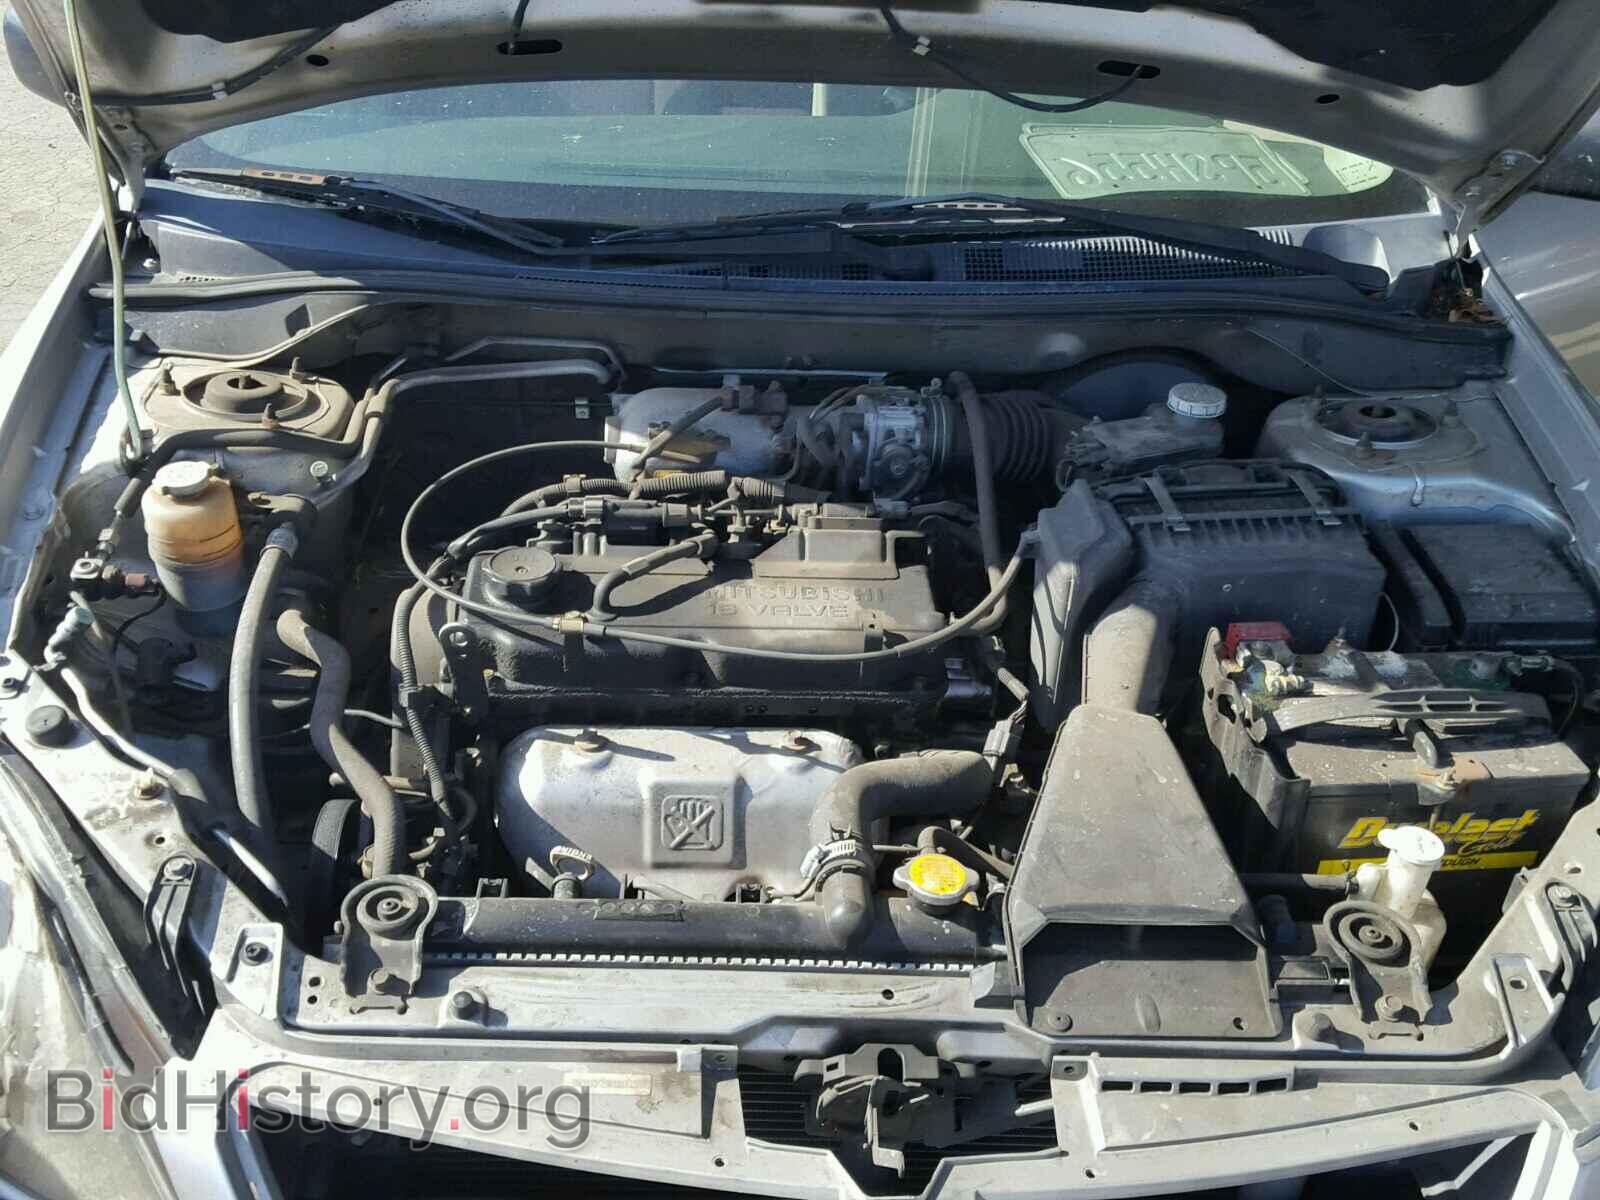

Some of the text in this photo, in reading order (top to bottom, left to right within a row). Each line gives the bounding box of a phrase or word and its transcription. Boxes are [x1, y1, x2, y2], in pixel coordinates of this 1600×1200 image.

[705, 582, 884, 602] MITSUBISHI
[710, 604, 849, 618] 16 VALVE
